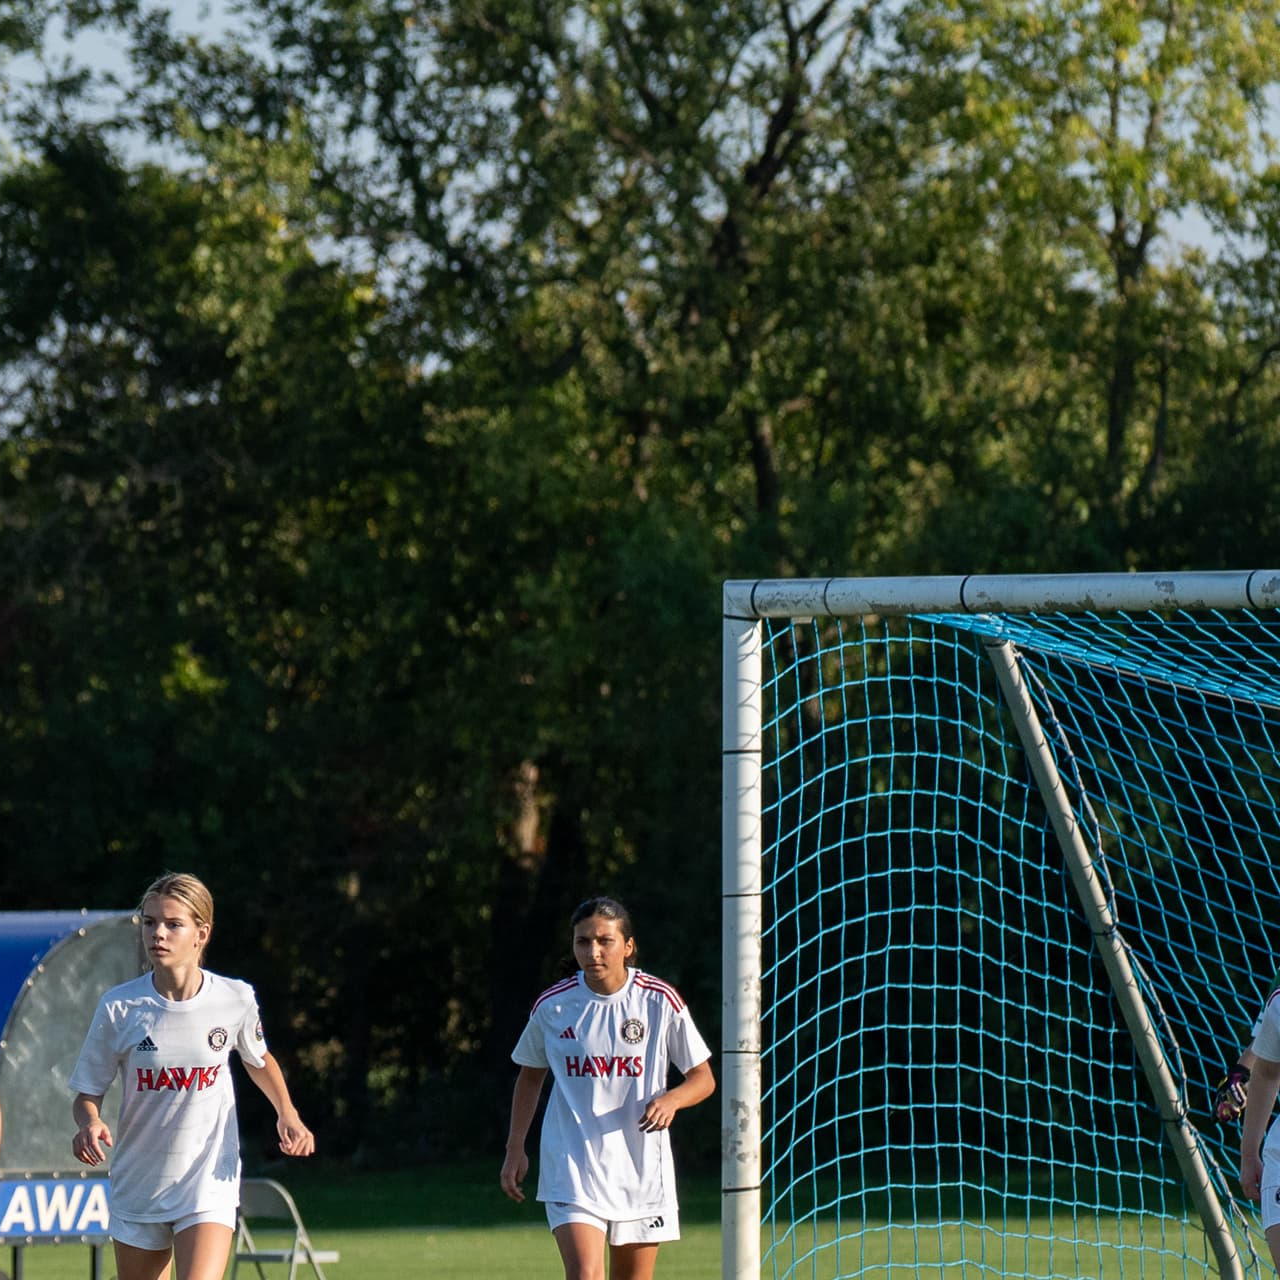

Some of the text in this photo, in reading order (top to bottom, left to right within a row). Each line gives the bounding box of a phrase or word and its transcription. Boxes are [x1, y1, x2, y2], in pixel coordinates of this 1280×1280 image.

[136, 1064, 221, 1091] HAWKS
[565, 1055, 643, 1078] HAWKS
[0, 1183, 109, 1232] AWA
